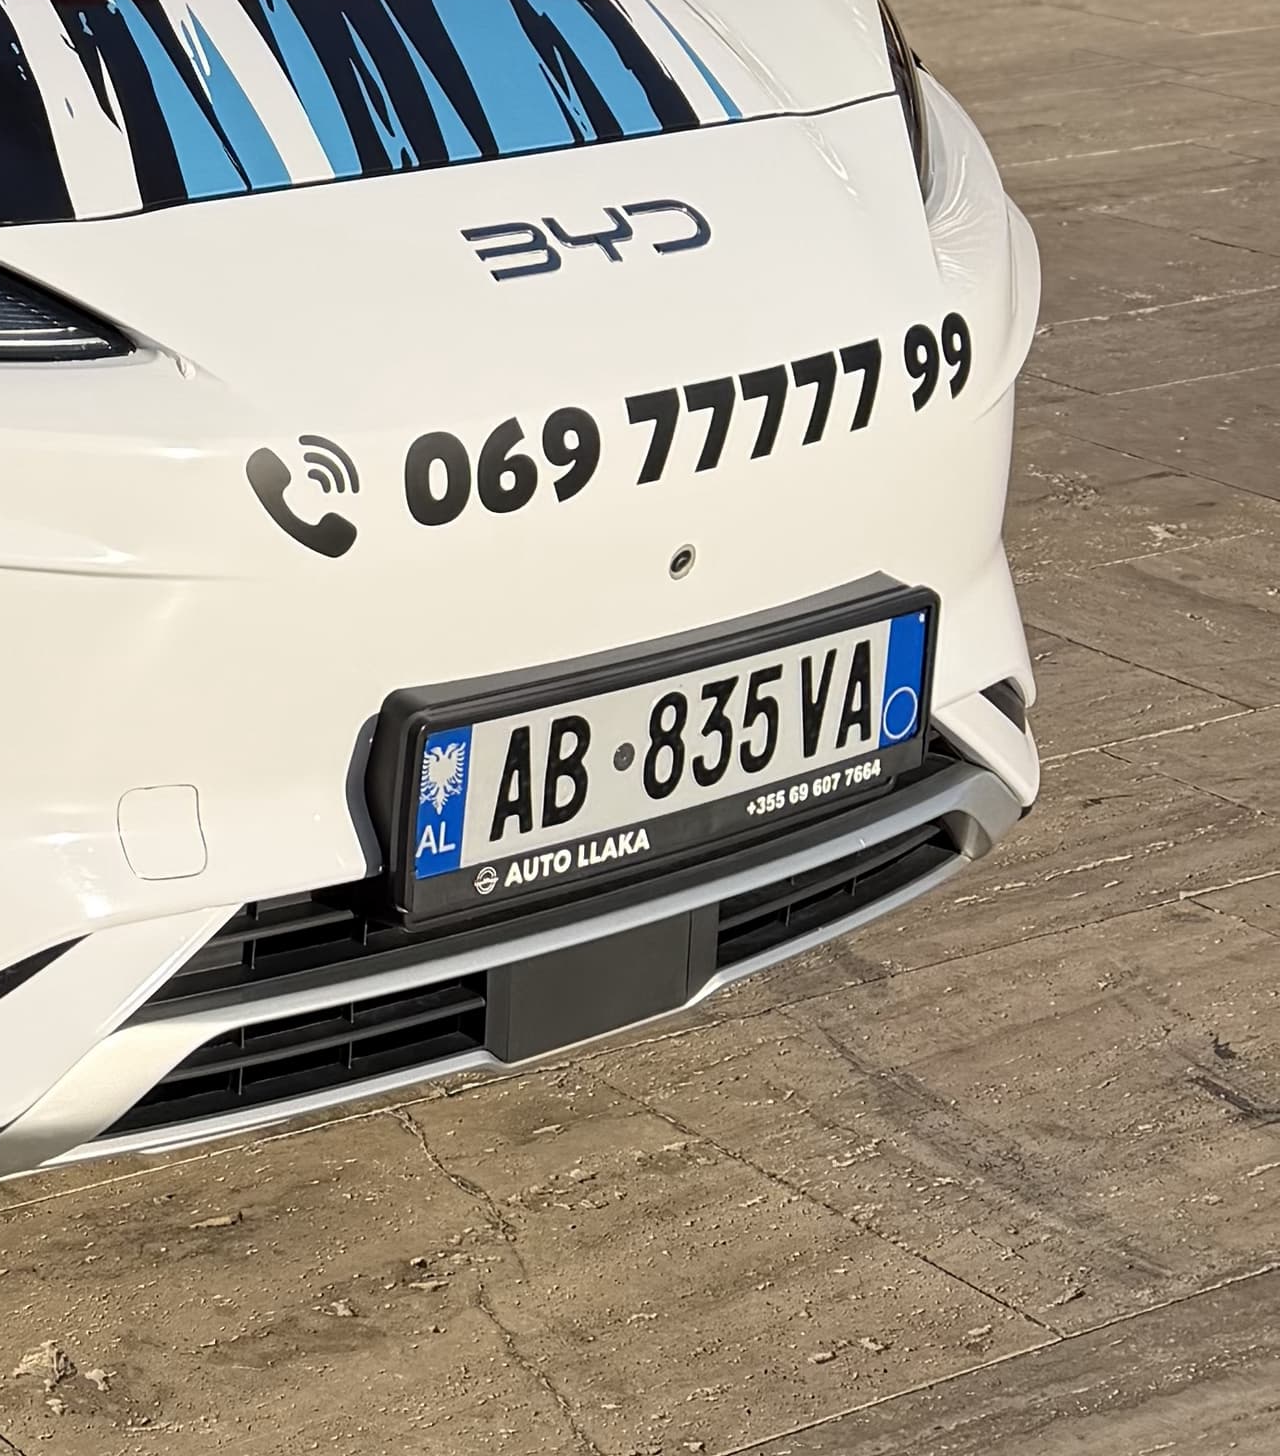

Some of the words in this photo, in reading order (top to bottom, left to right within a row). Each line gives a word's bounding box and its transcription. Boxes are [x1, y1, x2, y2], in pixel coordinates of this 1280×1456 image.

[460, 199, 712, 282] BYD
[404, 406, 601, 527] 069
[624, 338, 882, 486] 77777
[902, 311, 972, 412] 99
[489, 714, 591, 842] AB
[643, 662, 784, 800] 835
[799, 639, 871, 758] VA
[746, 789, 785, 817] +355
[788, 782, 809, 804] 69
[812, 772, 841, 798] 607
[844, 758, 881, 787] 7664
[416, 821, 456, 858] AL
[504, 851, 571, 887] AUTO
[578, 829, 650, 867] LLAKA
